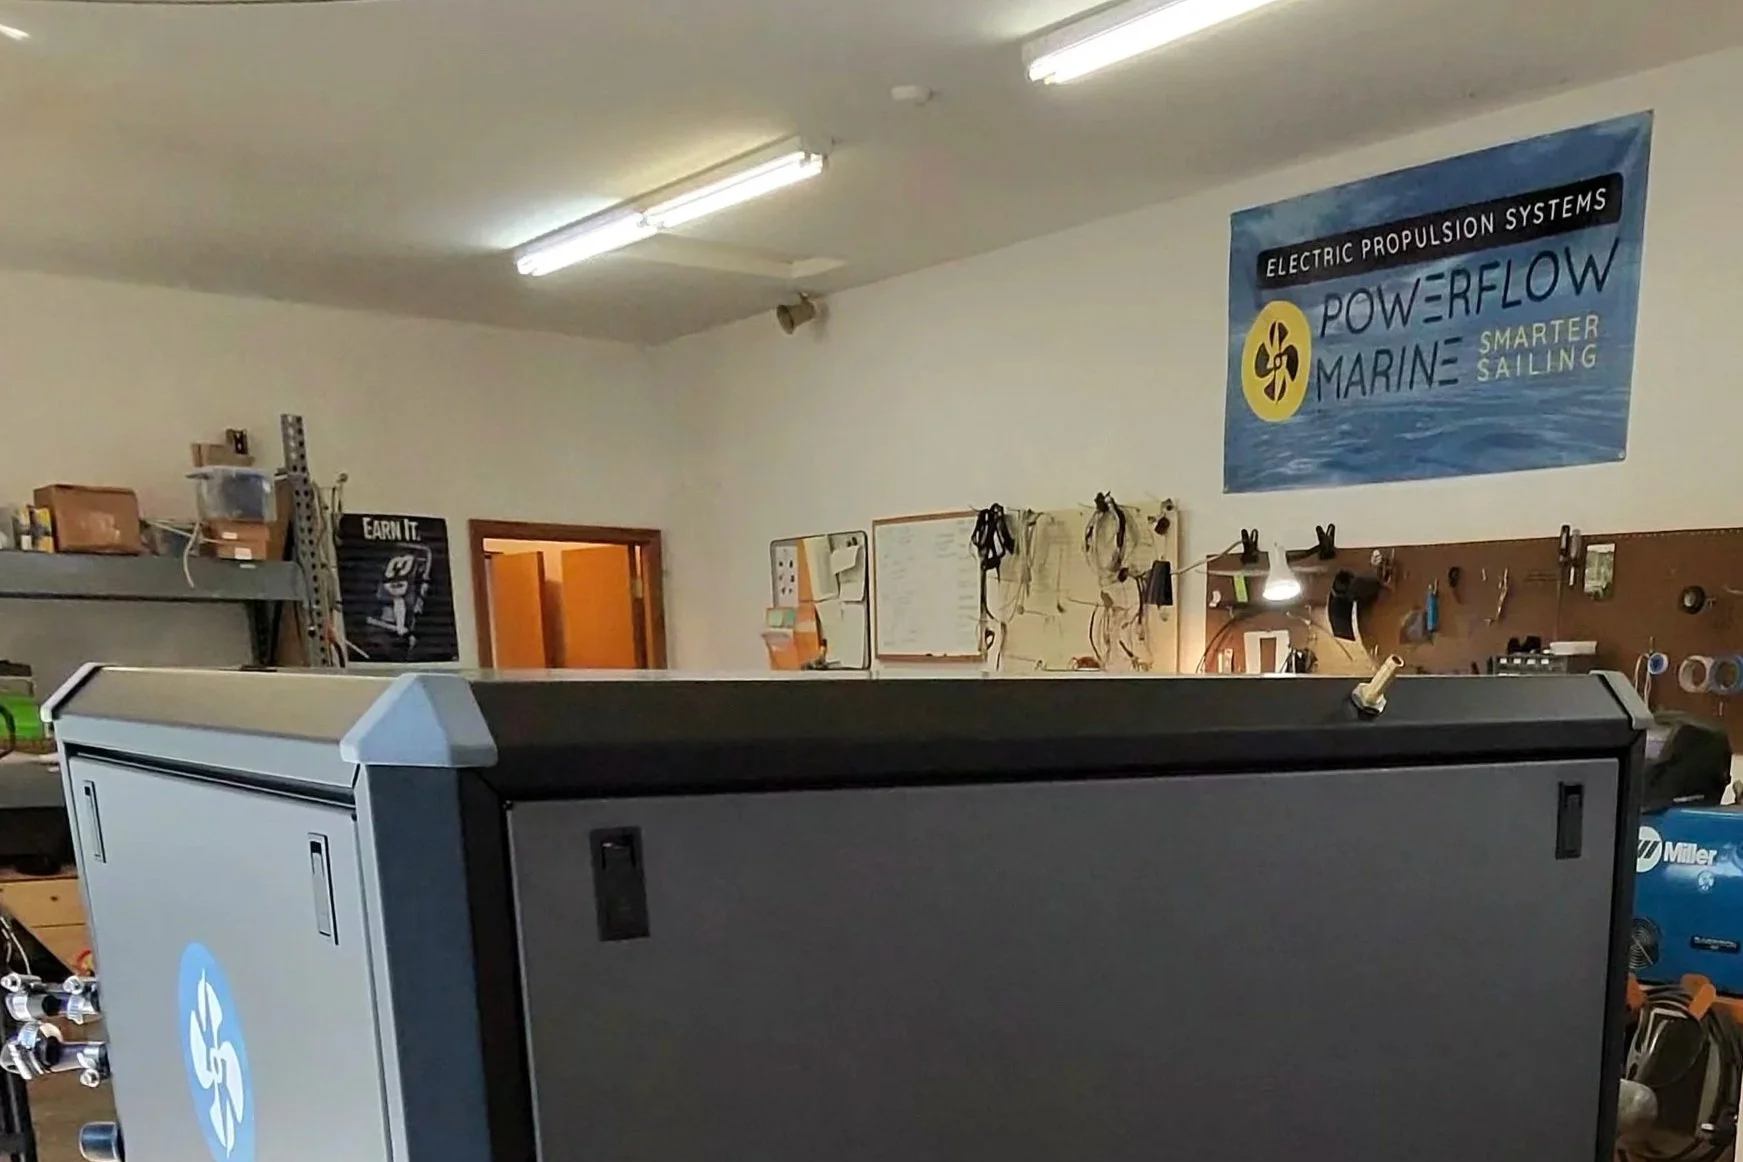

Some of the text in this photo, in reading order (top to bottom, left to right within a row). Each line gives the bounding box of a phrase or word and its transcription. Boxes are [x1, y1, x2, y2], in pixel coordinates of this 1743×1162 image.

[1266, 188, 1607, 277] ELECTRIC PROPULSION SYSTEMS
[1320, 238, 1619, 338] POWERFLOW
[1480, 315, 1598, 354] SMARTER
[1317, 337, 1462, 401] MARINE
[1477, 344, 1597, 381] SAILING
[362, 517, 401, 540] EARN
[1663, 841, 1717, 865] Miller
